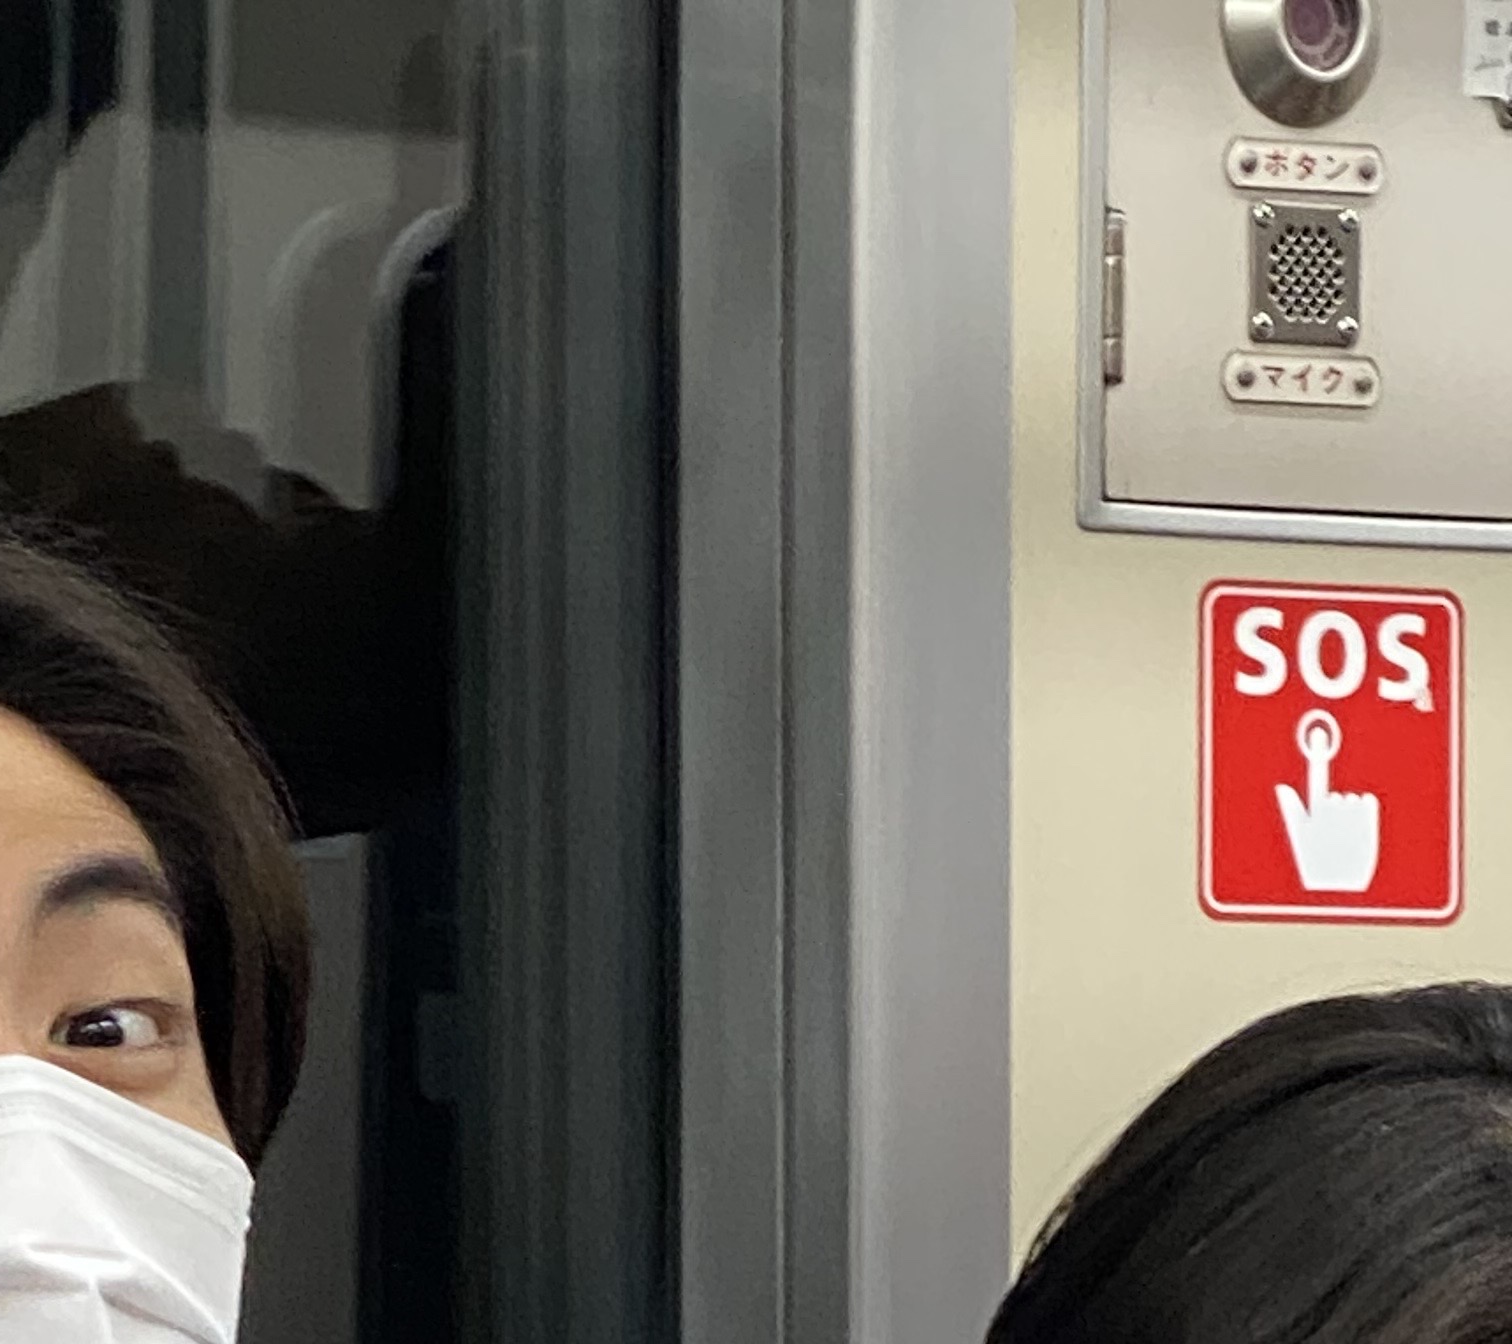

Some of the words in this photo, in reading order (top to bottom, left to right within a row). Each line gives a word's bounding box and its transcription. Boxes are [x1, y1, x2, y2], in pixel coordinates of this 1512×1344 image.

[1260, 363, 1344, 395] マイク
[1233, 606, 1431, 702] SOS
